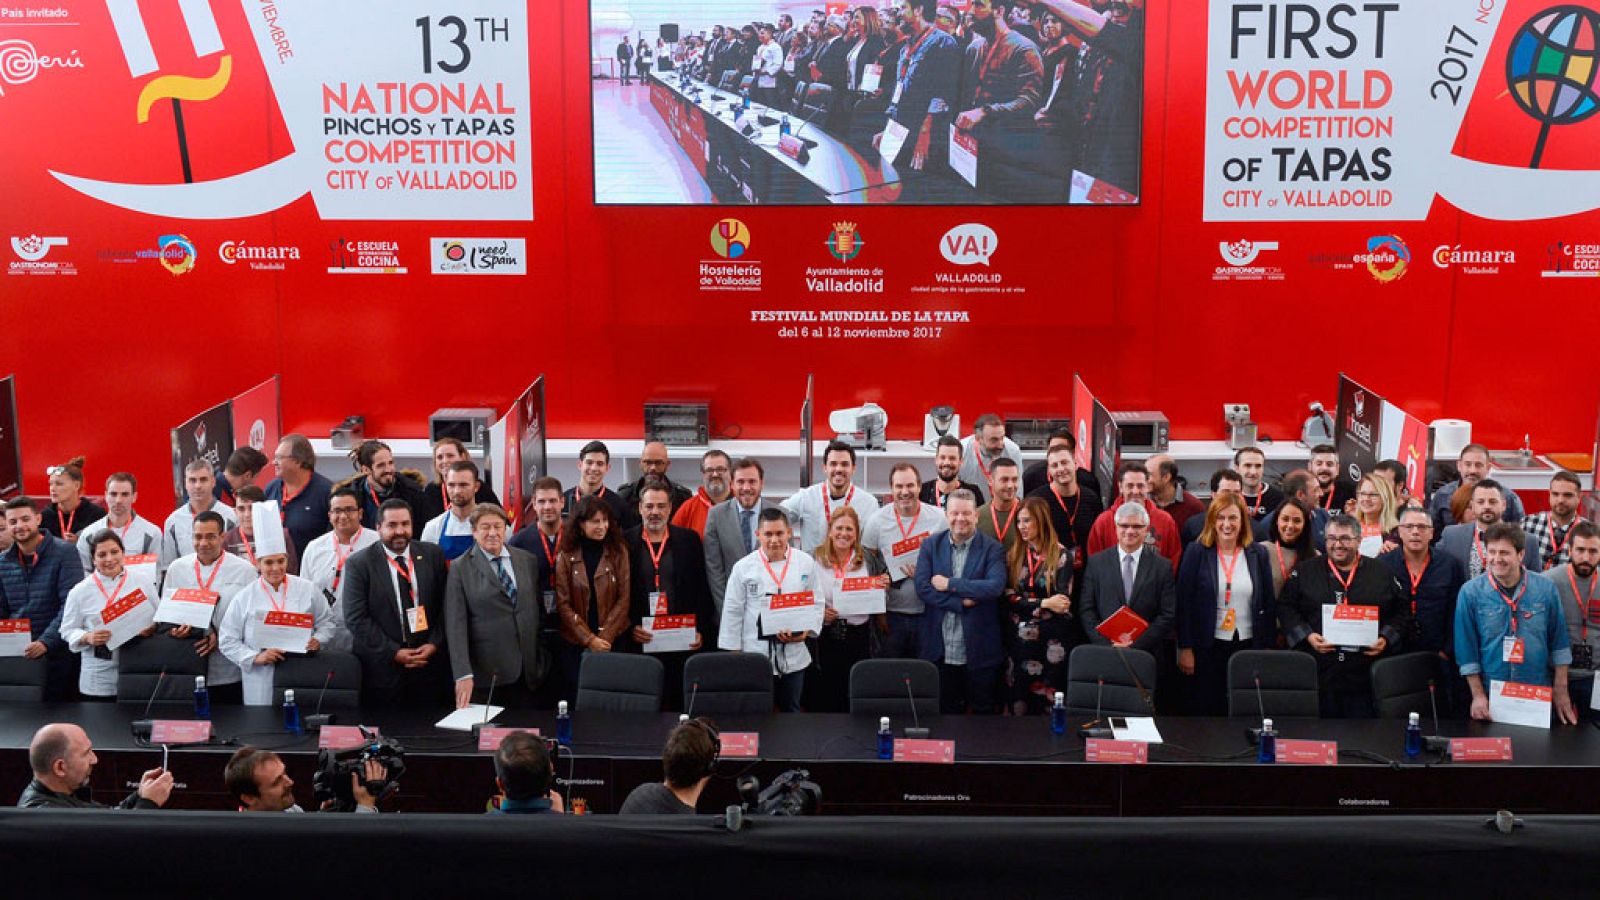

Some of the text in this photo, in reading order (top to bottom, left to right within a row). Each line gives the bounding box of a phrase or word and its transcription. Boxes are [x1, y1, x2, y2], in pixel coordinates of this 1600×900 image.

[1230, 3, 1400, 59] FIRST
[1430, 24, 1478, 106] 2017
[322, 82, 516, 114] NATIONAL
[1227, 70, 1393, 110] WORLD
[324, 118, 422, 136] PINCHOS
[441, 118, 515, 136] TAPAS
[1223, 116, 1393, 139] COMPETITION
[324, 139, 516, 164] COMPETITION
[1222, 147, 1392, 182] OF TAPAS
[326, 170, 518, 190] CITY OF VALLADOLID
[1223, 190, 1262, 207] CITY
[1283, 189, 1393, 207] VALLADOLID
[218, 240, 301, 264] Cámara
[358, 241, 399, 251] ESCUELA
[478, 240, 508, 255] need
[945, 234, 990, 257] VA!
[358, 256, 400, 267] COCINA
[478, 253, 517, 269] Spain
[1432, 244, 1516, 269] Cámara
[699, 264, 761, 275] Hostelería
[806, 266, 884, 278] Ayuntamiento de
[700, 276, 761, 285] de Valladolid
[806, 277, 884, 292] Valladolid
[935, 273, 1002, 283] VALLADOLID
[751, 310, 970, 322] FESTIVAL MUNDIAL DE LA TAPA
[778, 327, 942, 339] del 6 al 12 noviembre 2017
[556, 778, 604, 786] Organizadores
[904, 793, 955, 801] Patrocinadores
[1338, 798, 1390, 806] Colaboradores
